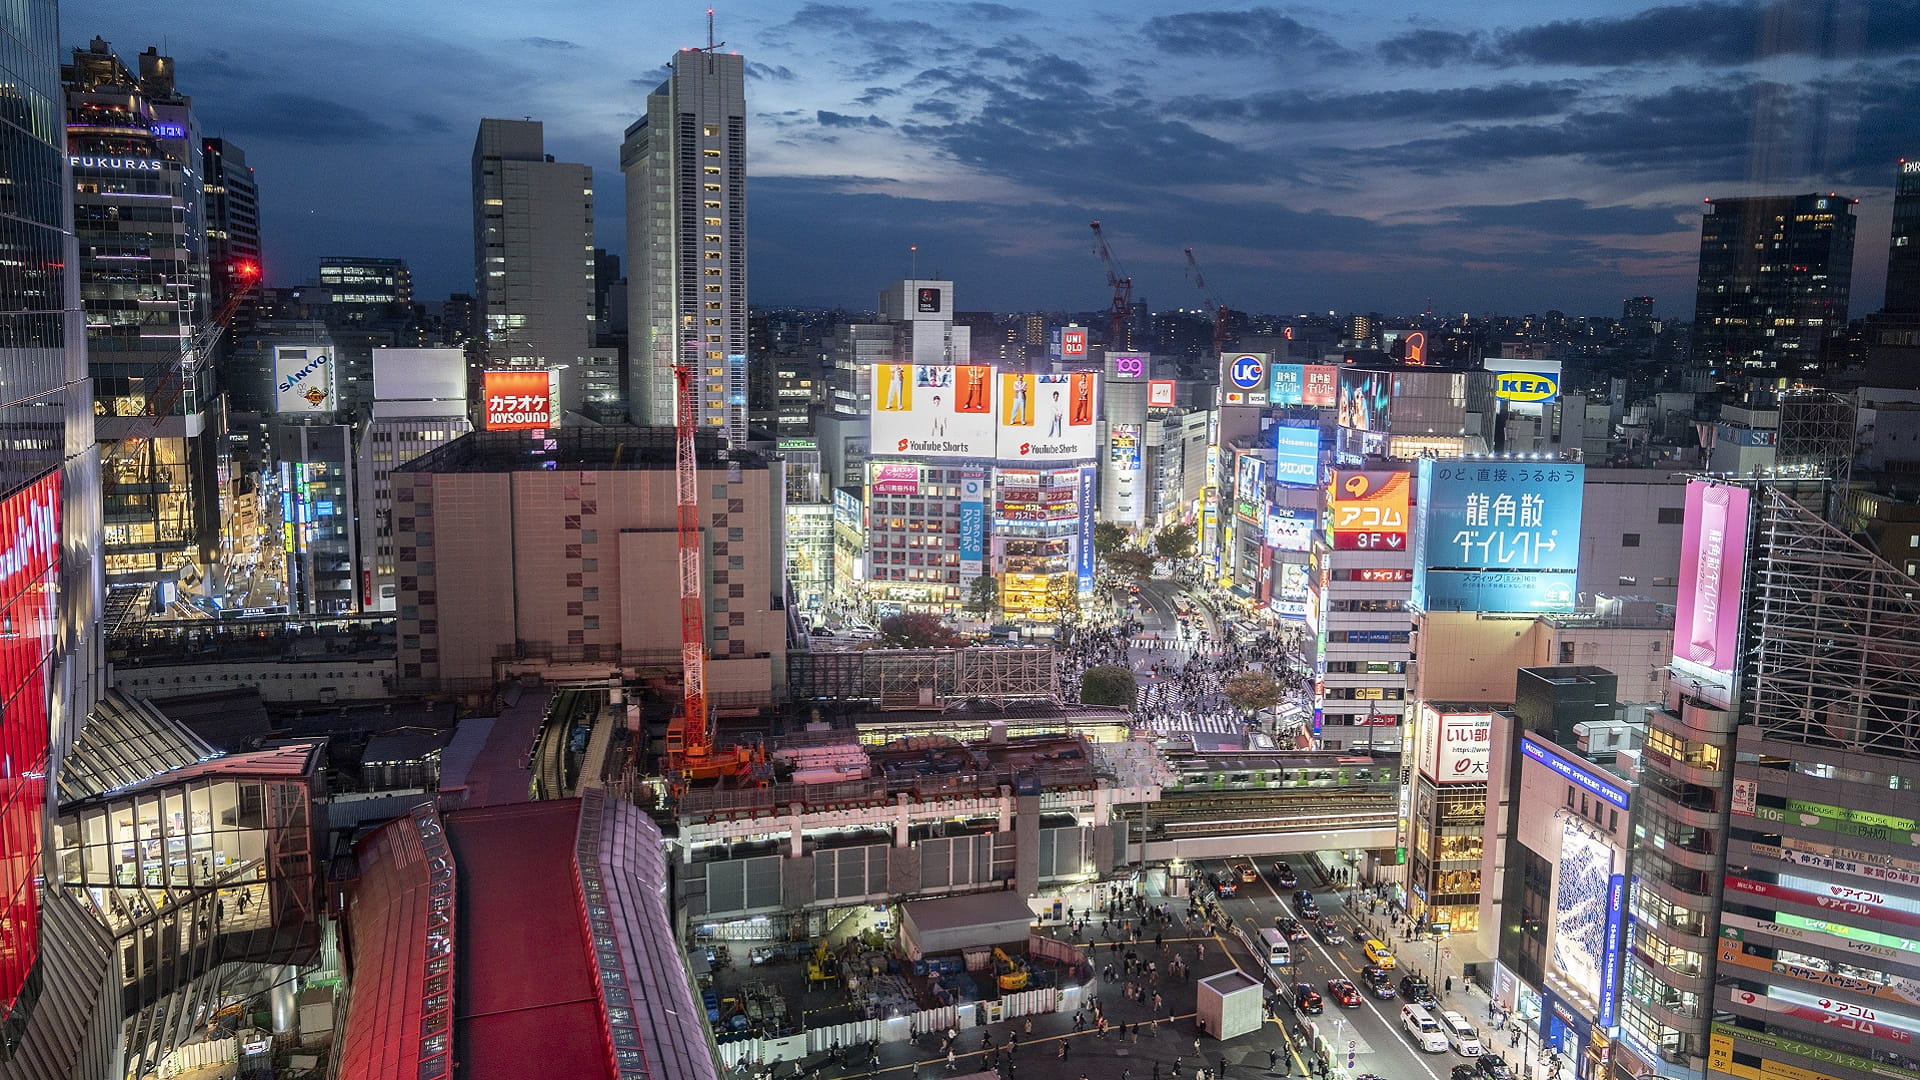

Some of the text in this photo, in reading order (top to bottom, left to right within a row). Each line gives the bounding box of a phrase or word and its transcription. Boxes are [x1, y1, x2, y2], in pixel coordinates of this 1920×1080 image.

[70, 157, 161, 170] FUKURAS
[1066, 334, 1081, 343] UNI
[1066, 344, 1082, 353] QLO
[279, 355, 327, 392] SANKYO
[1116, 358, 1143, 377] 109
[1234, 364, 1262, 381] UC
[489, 395, 548, 412] カラオケ
[489, 412, 549, 424] JOYSOUND
[909, 440, 969, 452] YouTube Shorts
[1031, 444, 1059, 454] YouTube
[1439, 467, 1576, 483] のど、直接、うるおう
[1341, 507, 1402, 526] アコム
[1465, 492, 1545, 528] 龍角散
[1358, 533, 1382, 548] 3F
[1452, 530, 1557, 565] ダイレクト
[1373, 571, 1403, 580] アイフル
[1447, 728, 1490, 742] いい部
[1762, 809, 1784, 822] 10F
[1807, 805, 1835, 816] HOUSE
[1801, 854, 1857, 873] 仲介手数料
[1843, 887, 1884, 904] アイフル
[1829, 899, 1870, 915] アイフル
[1900, 938, 1917, 951] 7F
[1723, 951, 1736, 961] 6F
[1835, 1002, 1876, 1020] アコム
[1823, 1013, 1909, 1041] アコム 5F
[1782, 1042, 1868, 1070] マインドフルネス
